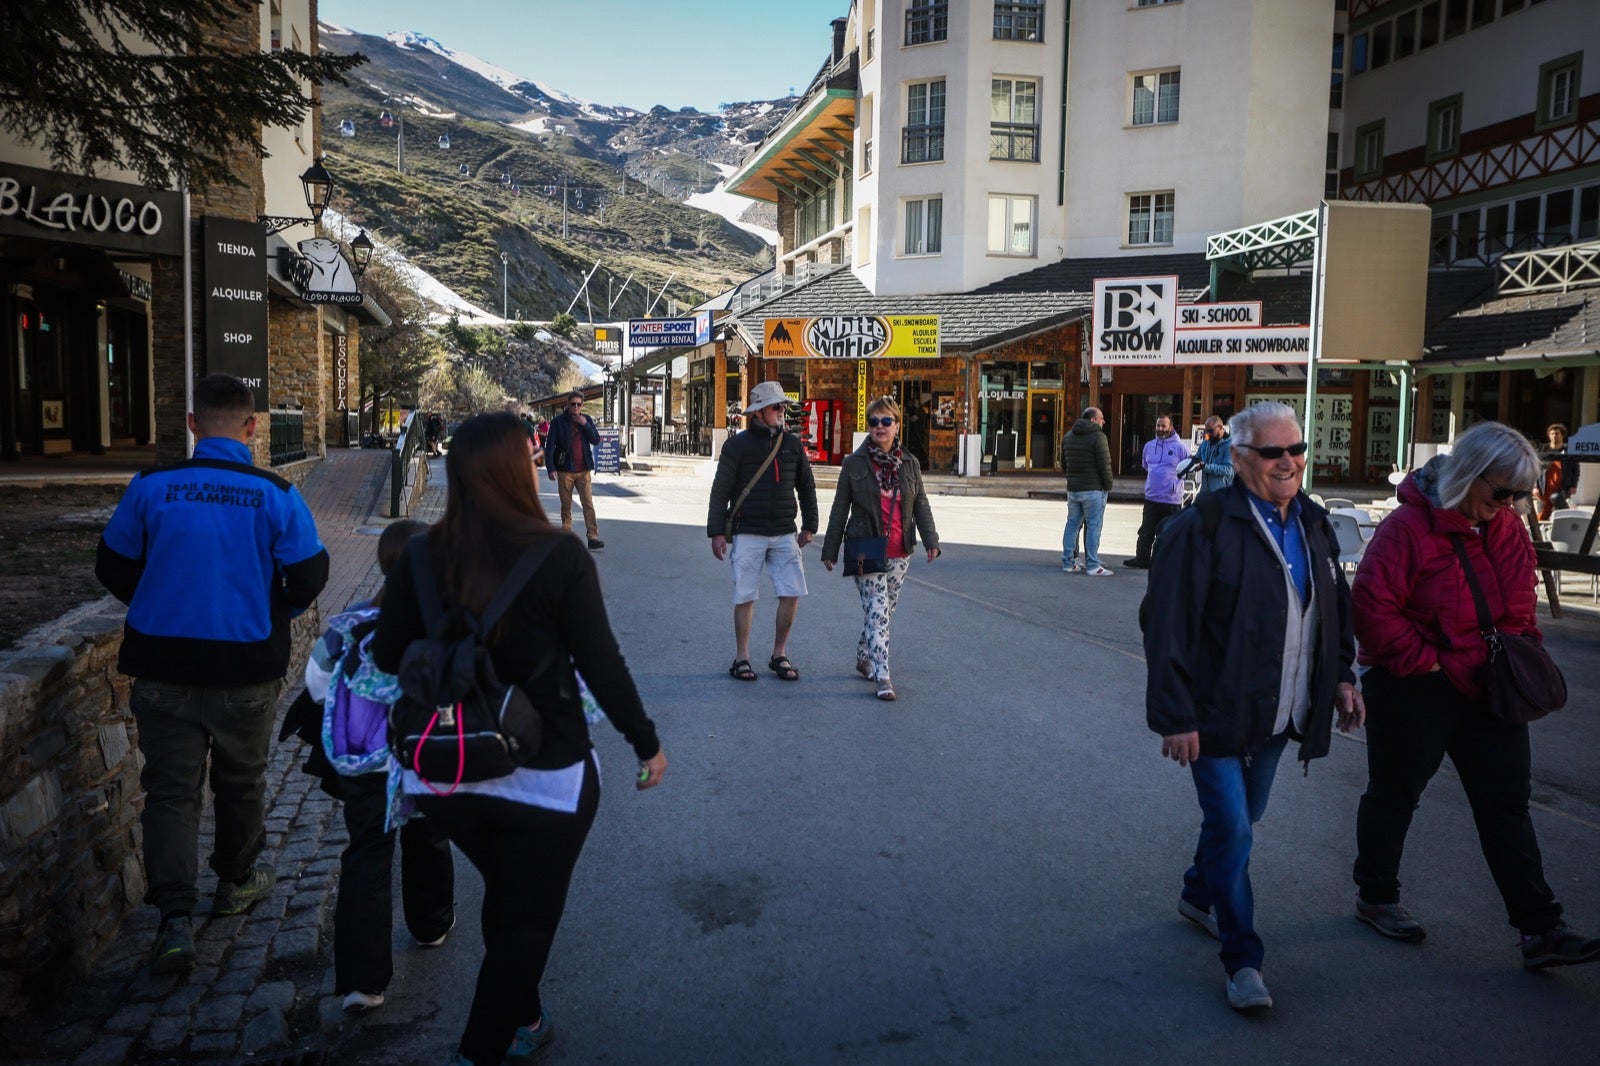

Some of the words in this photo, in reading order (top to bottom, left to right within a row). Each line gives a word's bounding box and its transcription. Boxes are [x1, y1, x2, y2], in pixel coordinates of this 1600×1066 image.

[0, 177, 162, 235] BLANCO
[217, 242, 256, 257] TIENDA
[212, 287, 262, 301] ALQUILER
[330, 294, 361, 302] BLANCO
[1104, 284, 1163, 333] BE
[1181, 309, 1199, 324] SKI
[1207, 307, 1253, 323] SCHOOL
[817, 317, 886, 341] White
[912, 329, 937, 337] ALQUILER
[223, 332, 253, 344] SHOP
[595, 340, 619, 351] pans
[631, 336, 660, 345] ALQUILER
[660, 336, 670, 344] SKI
[671, 336, 695, 345] RENTAL
[913, 337, 937, 346] ESCUELA
[1100, 331, 1164, 352] SNOW
[917, 345, 937, 354] TIENDA
[1175, 338, 1222, 354] ALQUILER
[1226, 338, 1242, 353] SKI
[337, 335, 347, 410] ESCUELA
[978, 390, 1024, 400] ALQUILER
[167, 482, 199, 493] TRAIL
[202, 483, 265, 497] RUNNING
[165, 492, 179, 503] EL
[184, 491, 261, 509] CAMPILLO
